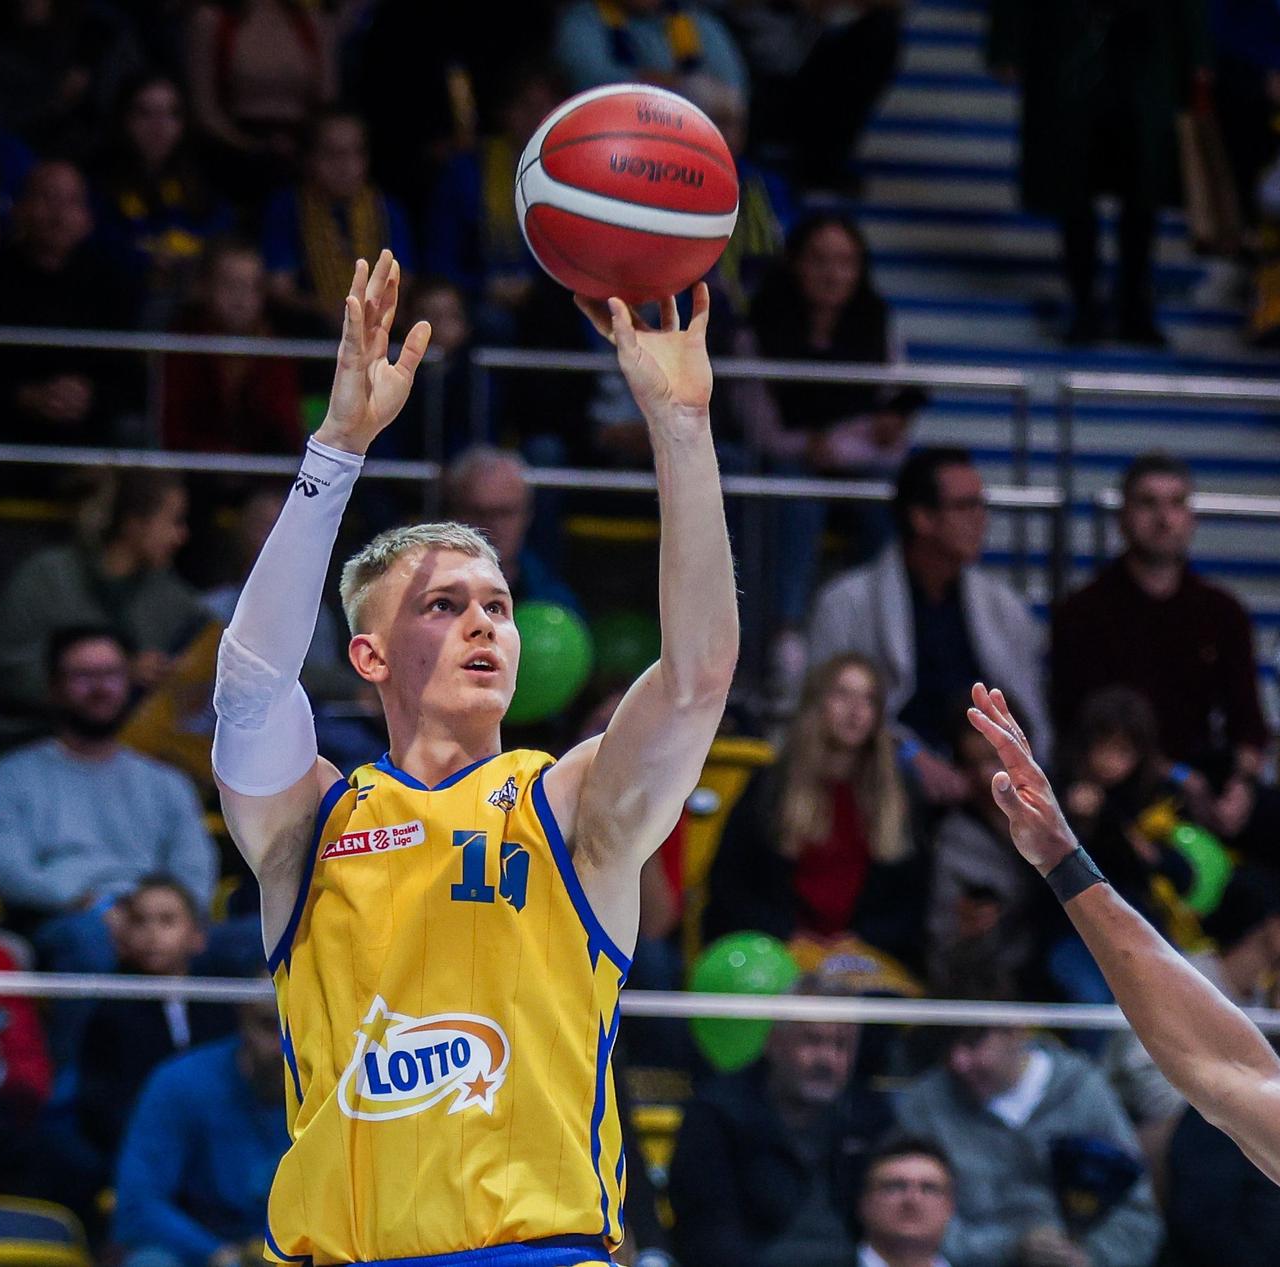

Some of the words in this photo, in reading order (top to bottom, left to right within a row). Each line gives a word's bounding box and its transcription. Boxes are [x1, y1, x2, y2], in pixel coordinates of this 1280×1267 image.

[610, 152, 705, 188] molten
[392, 824, 419, 837] Basket
[325, 837, 366, 856] LEN
[394, 837, 412, 846] Liga
[365, 1037, 471, 1095] LOTTO
